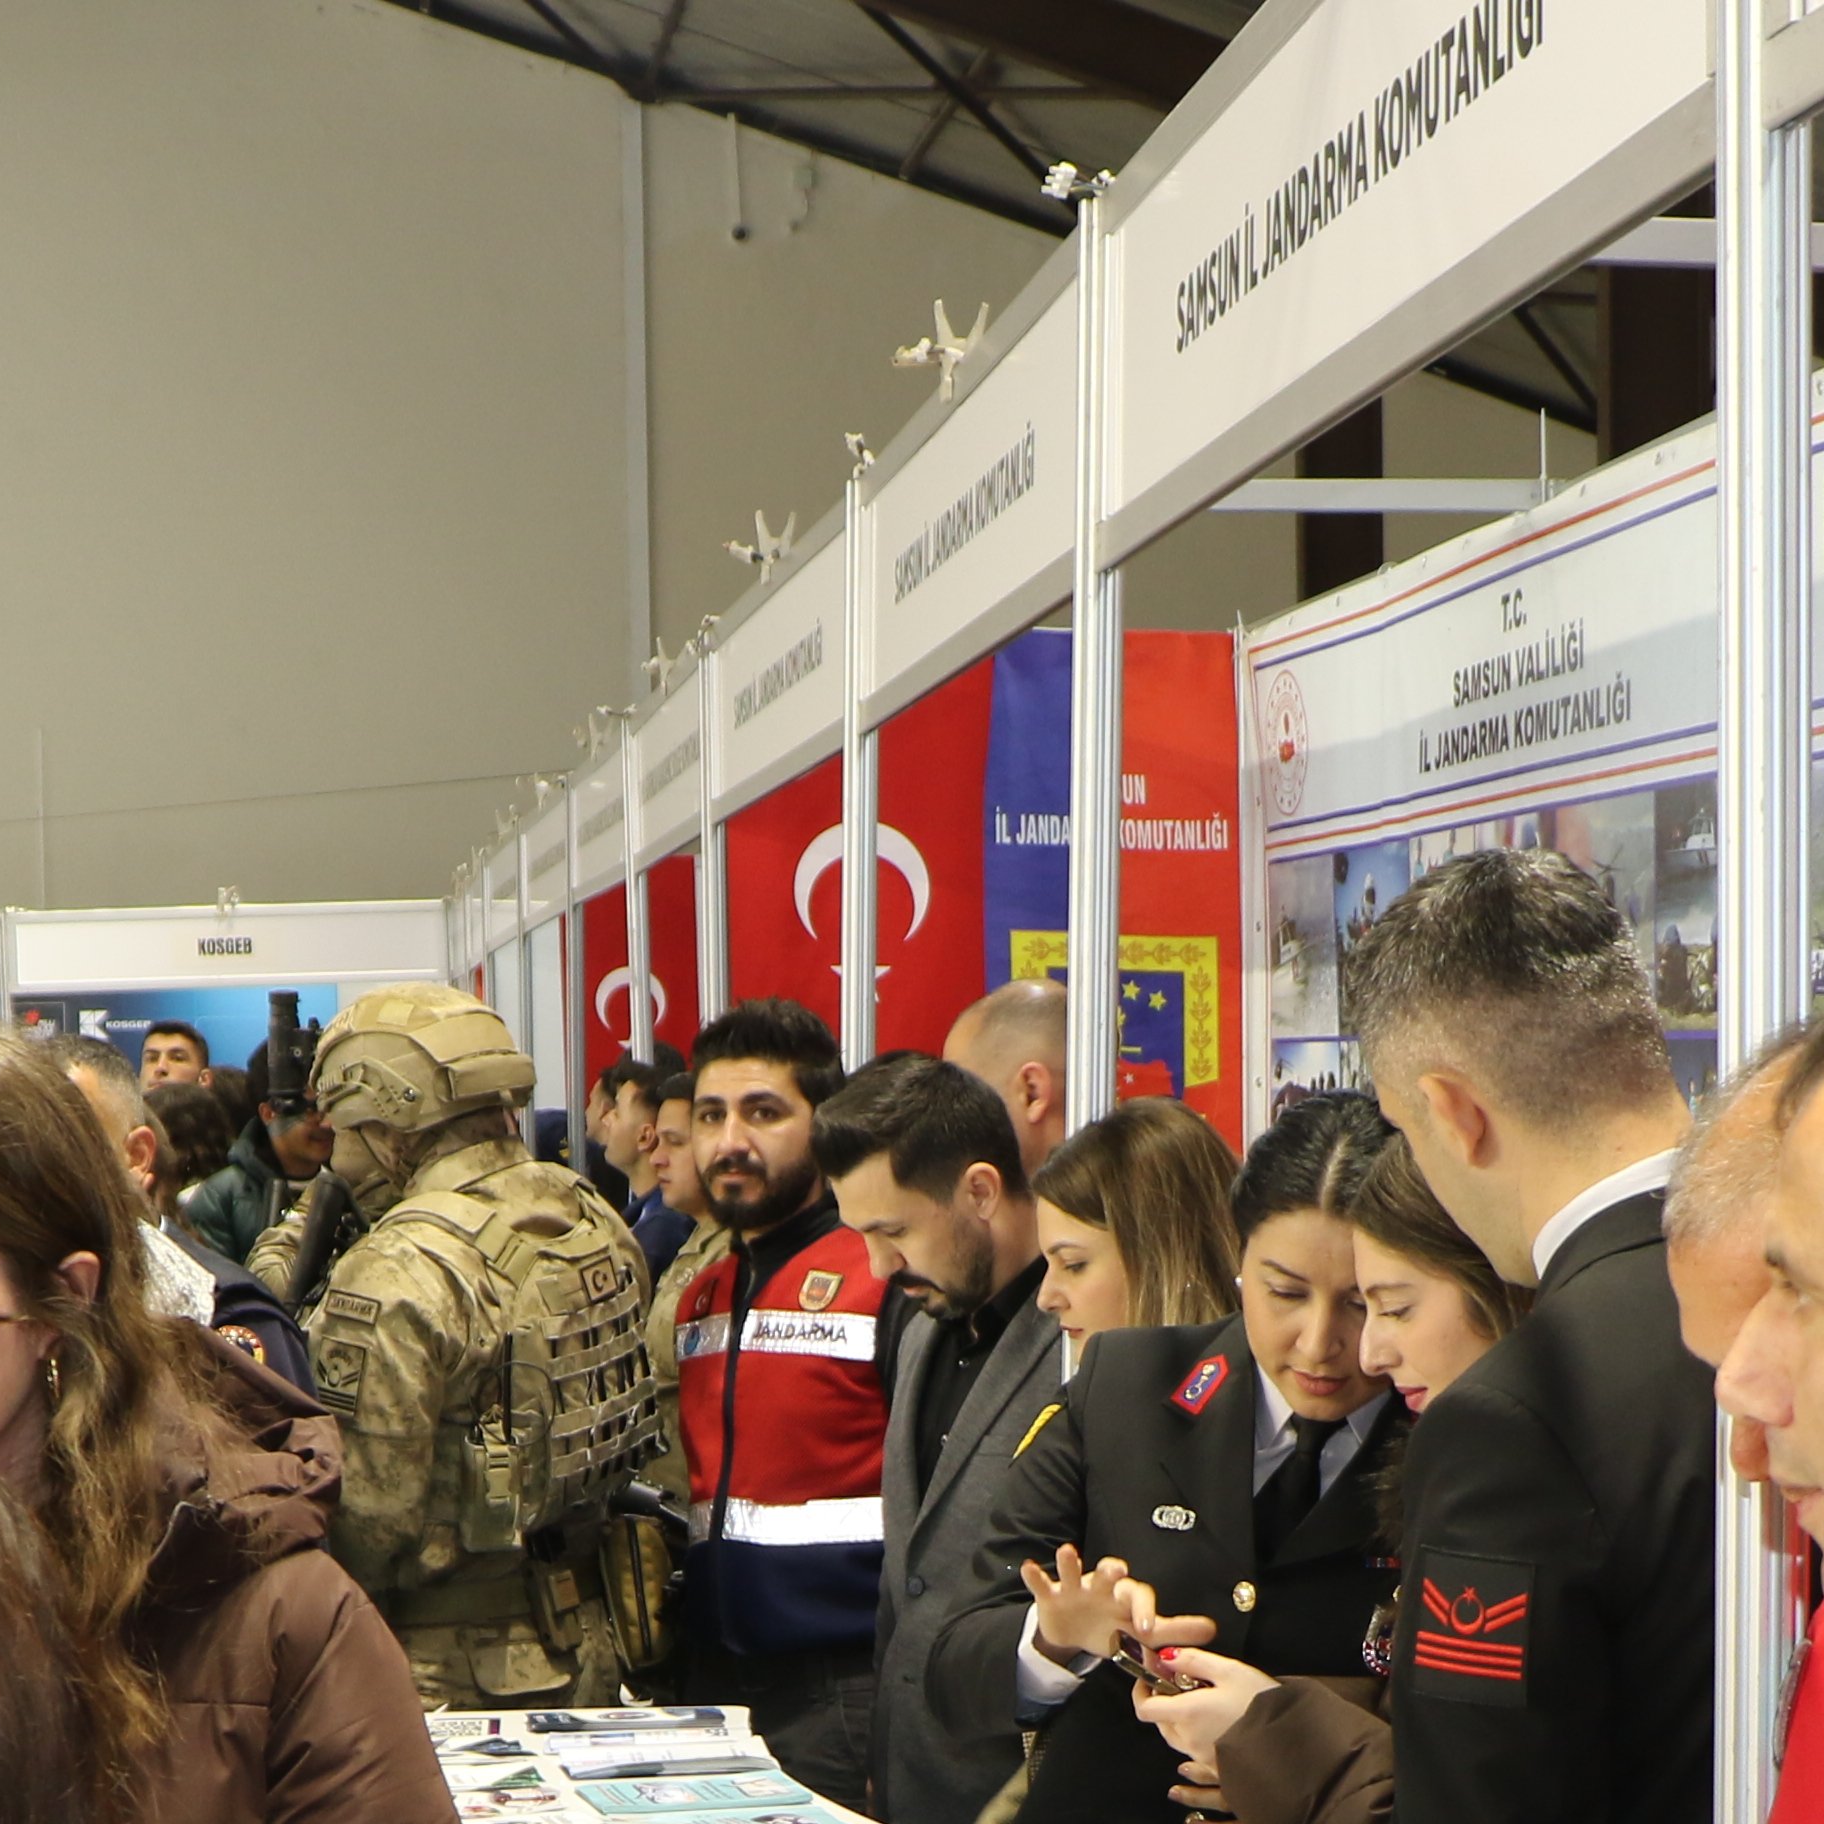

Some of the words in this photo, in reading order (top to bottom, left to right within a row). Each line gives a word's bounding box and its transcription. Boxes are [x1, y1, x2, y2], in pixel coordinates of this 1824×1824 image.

[1175, 227, 1240, 355] SAMSUN
[1244, 202, 1258, 297] İL
[1262, 110, 1368, 280] JANDARMA
[1501, 587, 1528, 634] T.C.
[1452, 655, 1512, 708] SAMSUN
[1515, 617, 1585, 684] VALİLİĞİ
[1418, 728, 1431, 775] İL
[1433, 719, 1510, 770] JANDARMA
[1513, 670, 1632, 746] KOMUTANLIĞI
[995, 805, 1011, 845] İL
[197, 936, 253, 956] KOSGEB
[751, 1322, 848, 1343] JANDARMA
